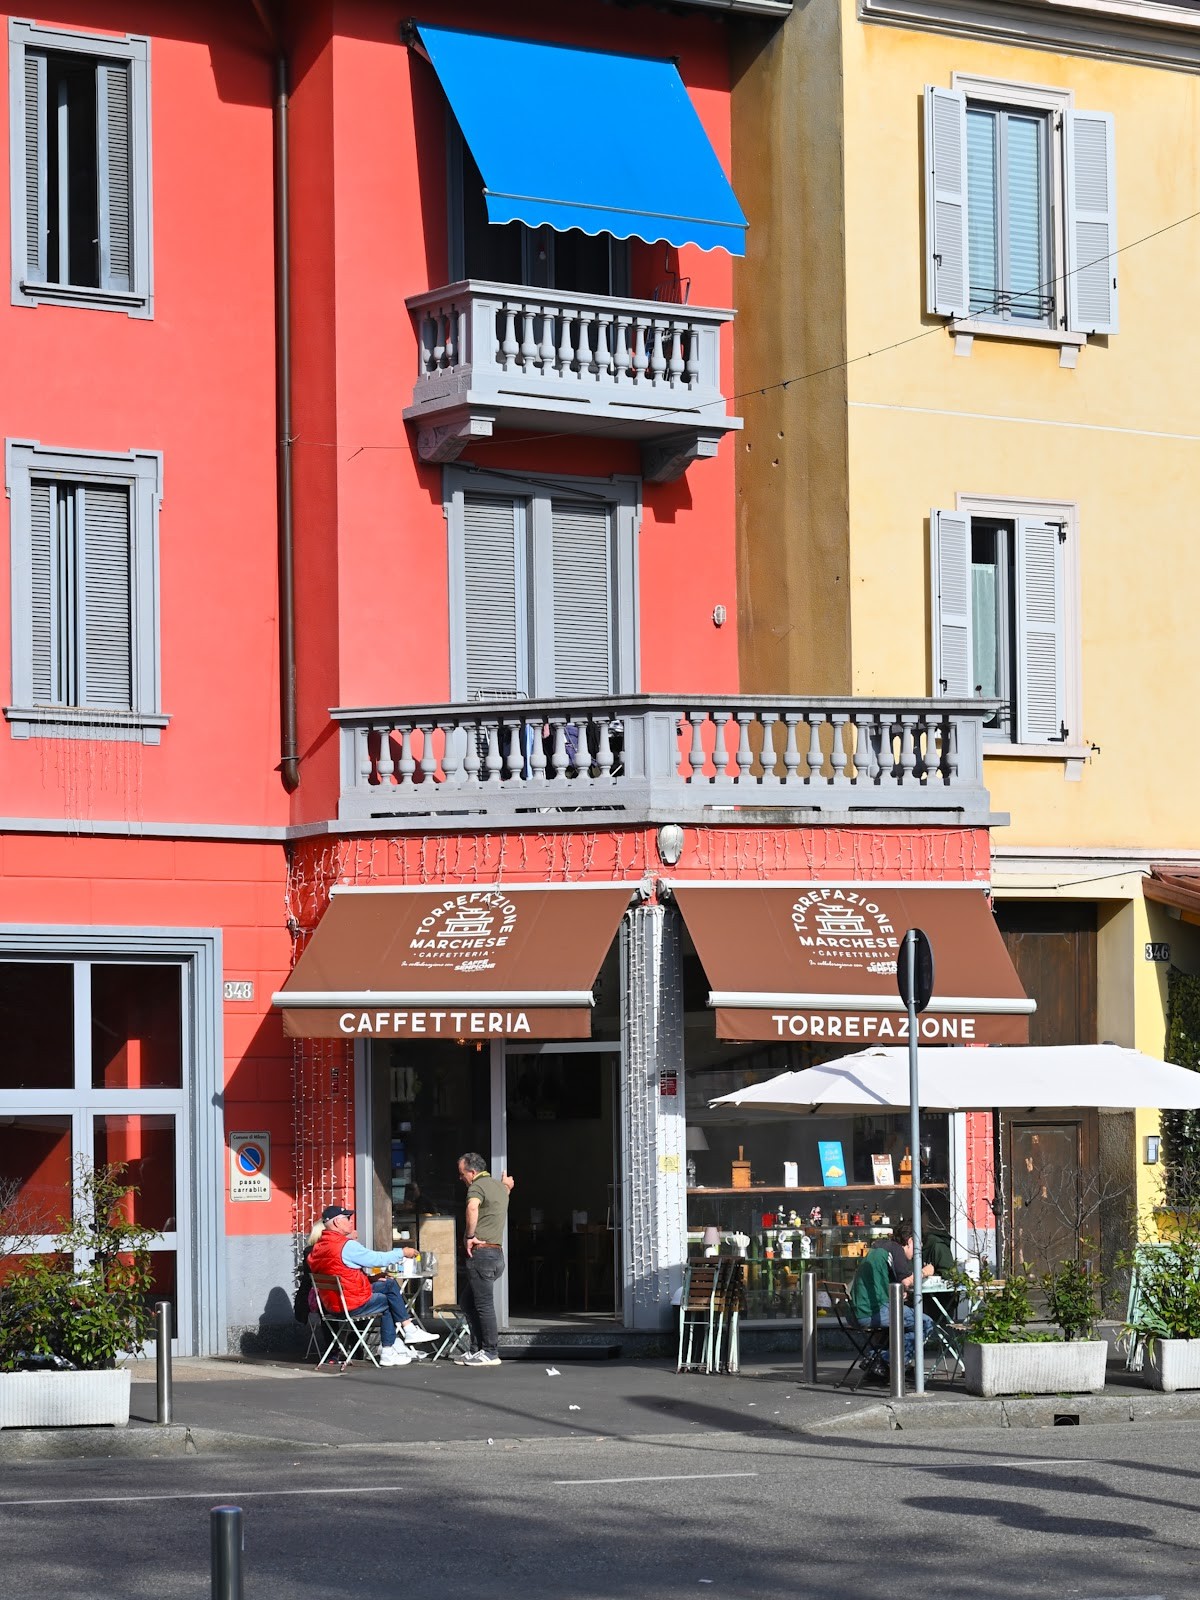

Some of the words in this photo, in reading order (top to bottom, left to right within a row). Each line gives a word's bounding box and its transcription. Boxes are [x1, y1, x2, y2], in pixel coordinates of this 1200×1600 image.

[415, 892, 517, 936] TORREFAZIONE
[791, 888, 894, 934] TORREFAZIONE
[409, 936, 509, 949] MARCHESE
[798, 935, 900, 949] MARCHESE
[418, 950, 489, 958] CAFFETTERIA
[818, 949, 890, 958] CAFFETTERIA
[1145, 944, 1169, 960] 346
[224, 981, 252, 999] 348
[338, 1012, 531, 1034] CAFFETTERIA
[772, 1014, 976, 1039] TORREFAZIONE
